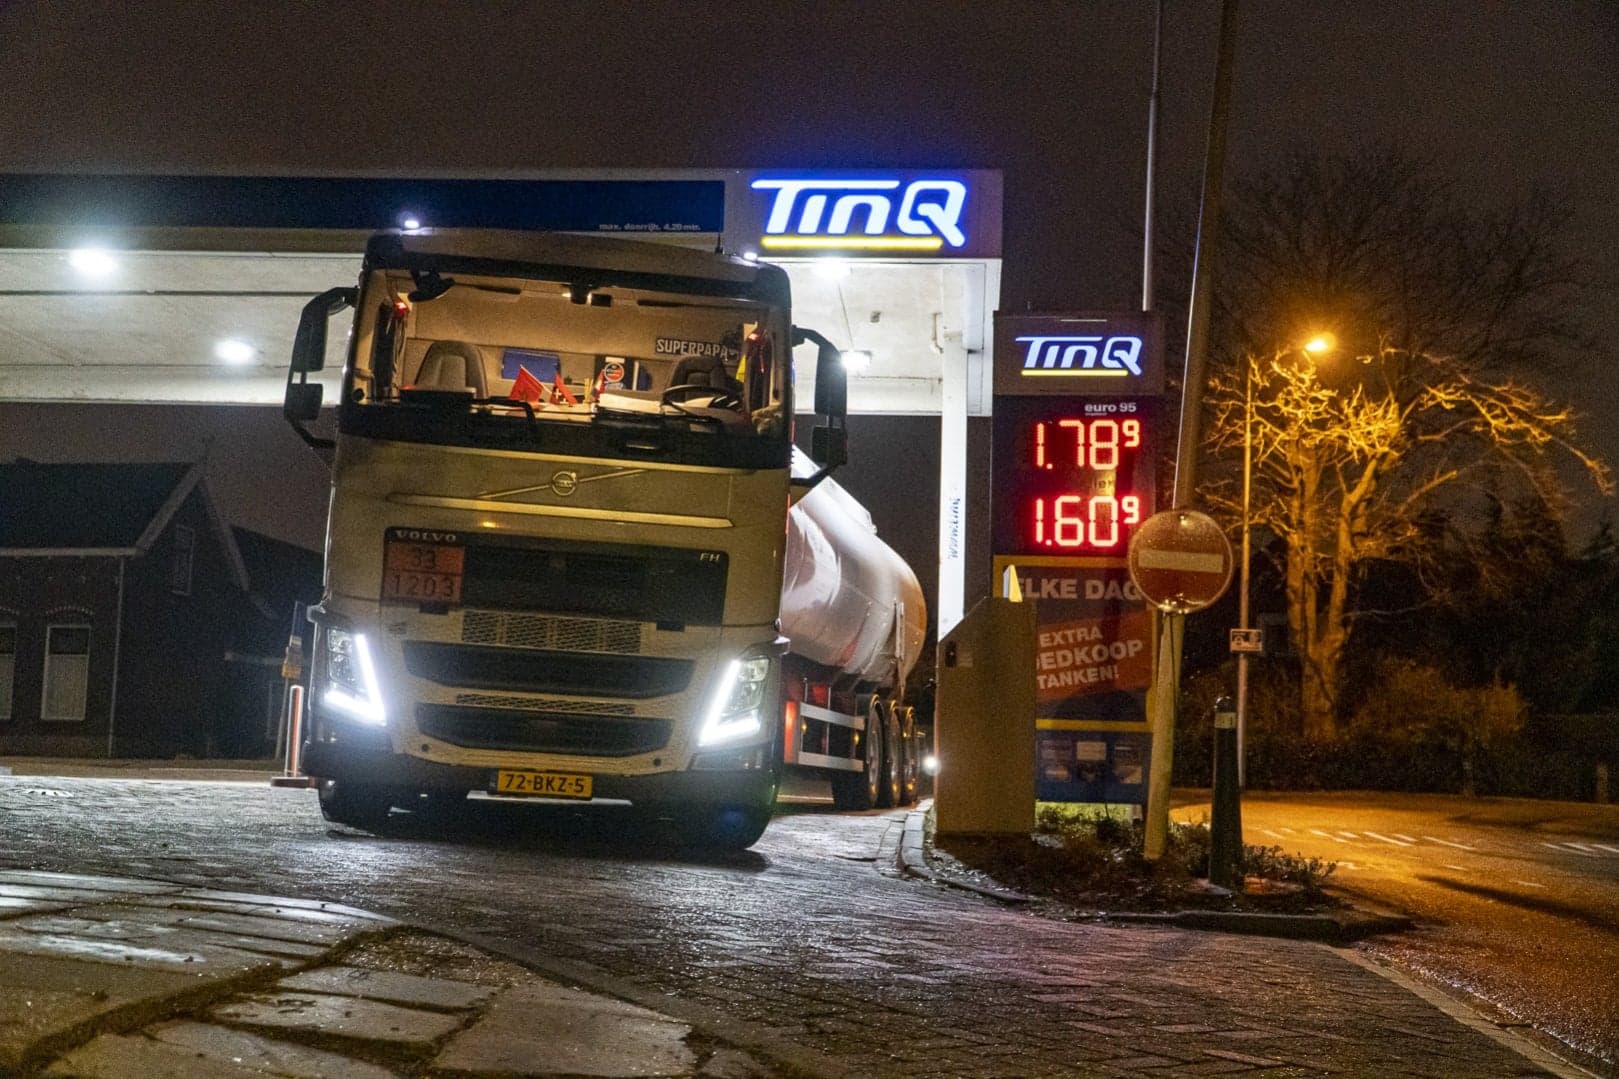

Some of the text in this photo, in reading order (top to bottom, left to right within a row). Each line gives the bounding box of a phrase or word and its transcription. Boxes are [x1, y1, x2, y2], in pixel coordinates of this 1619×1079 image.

[1084, 402, 1137, 412] euro 95
[395, 530, 457, 542] VOLVO
[415, 548, 437, 569] 33
[390, 574, 455, 597] 1203
[1040, 626, 1103, 648] EXTRA
[1037, 665, 1120, 689] TANKEN!
[505, 774, 585, 793] 72-BKZ-5
